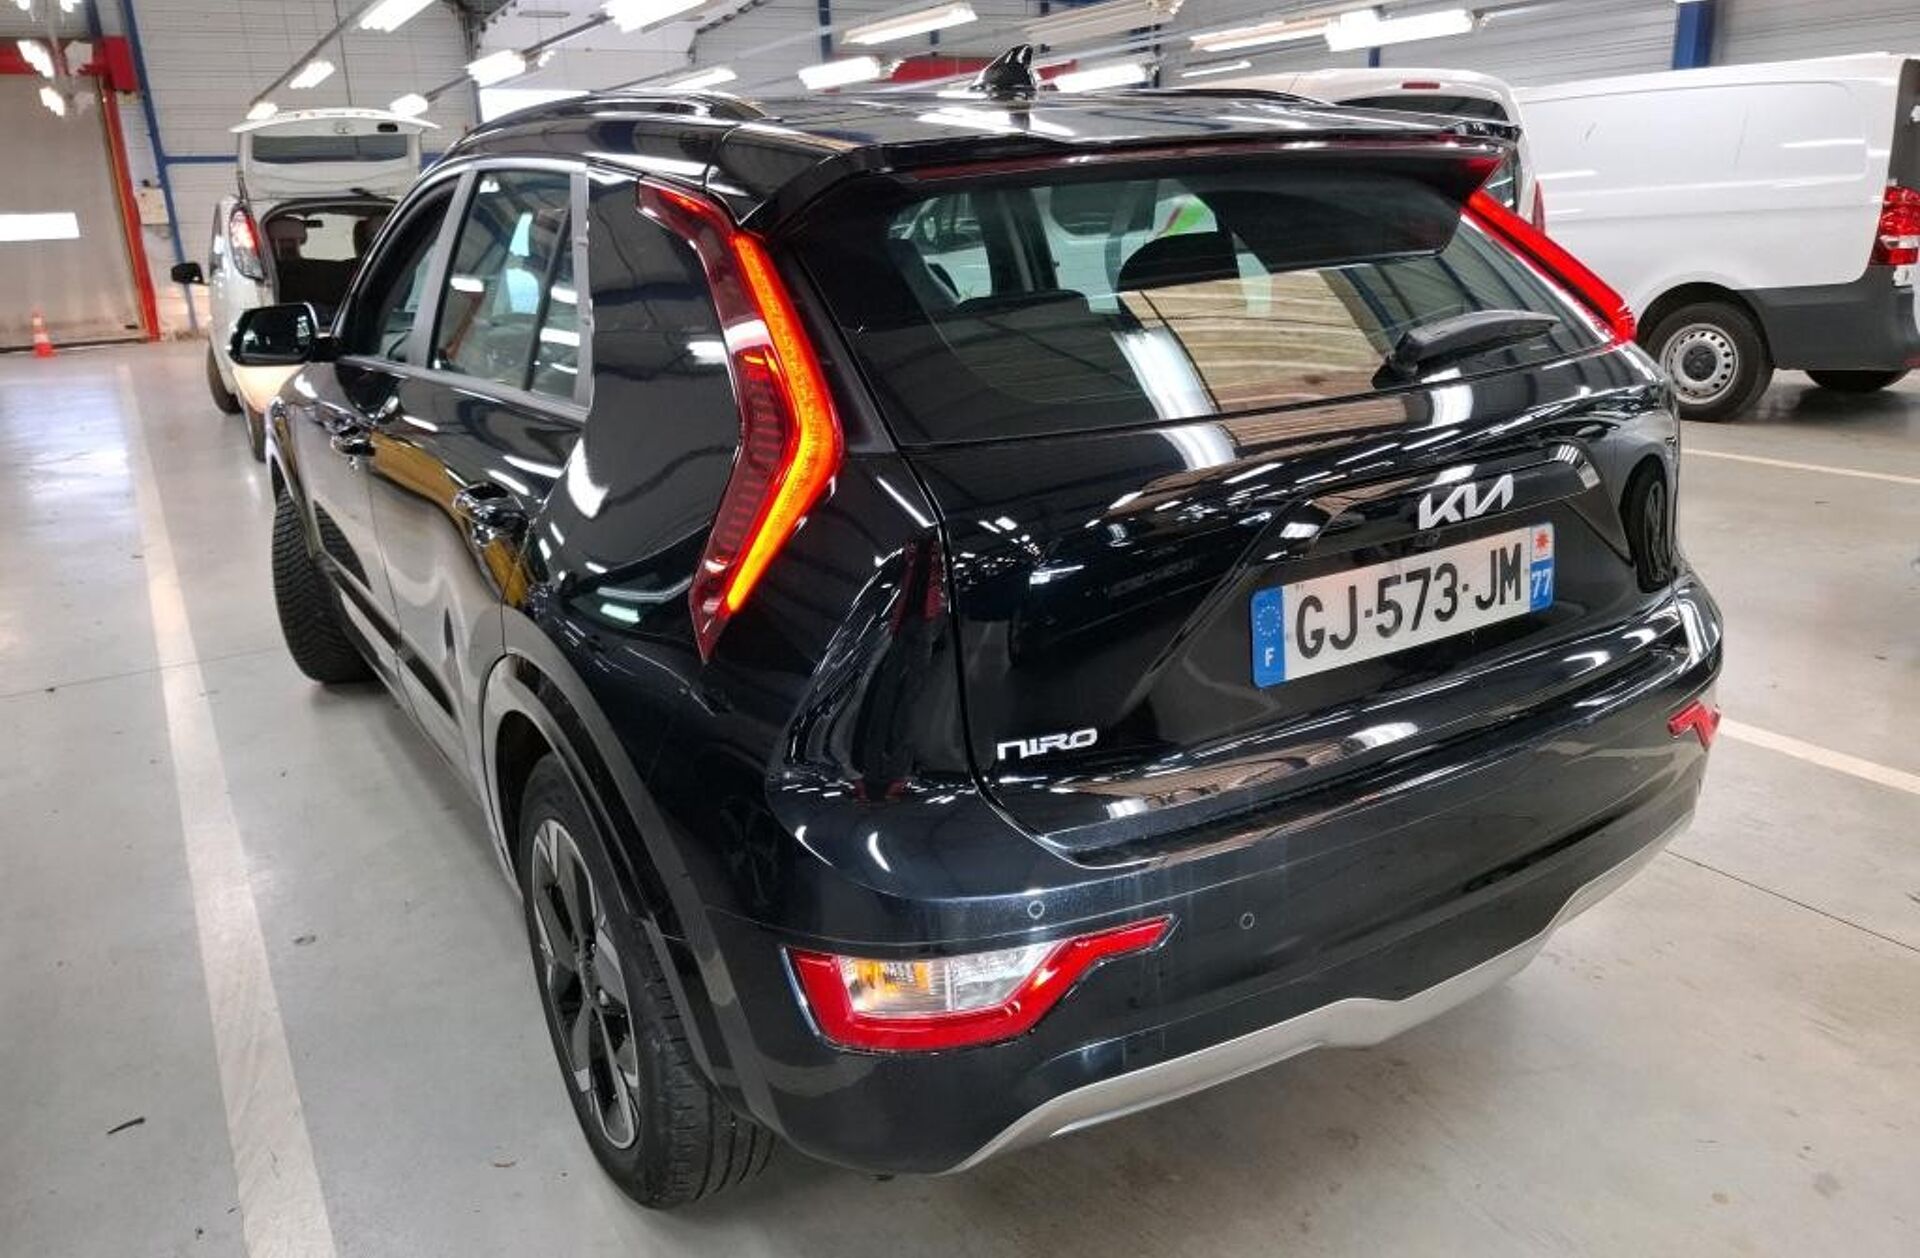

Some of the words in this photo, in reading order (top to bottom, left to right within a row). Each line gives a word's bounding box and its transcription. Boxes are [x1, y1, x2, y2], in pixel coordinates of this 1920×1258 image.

[1419, 474, 1514, 530] KIA
[1531, 568, 1551, 599] 77
[1296, 541, 1522, 659] GJ-573-JM
[1265, 647, 1275, 667] F
[997, 728, 1098, 760] NIRO
